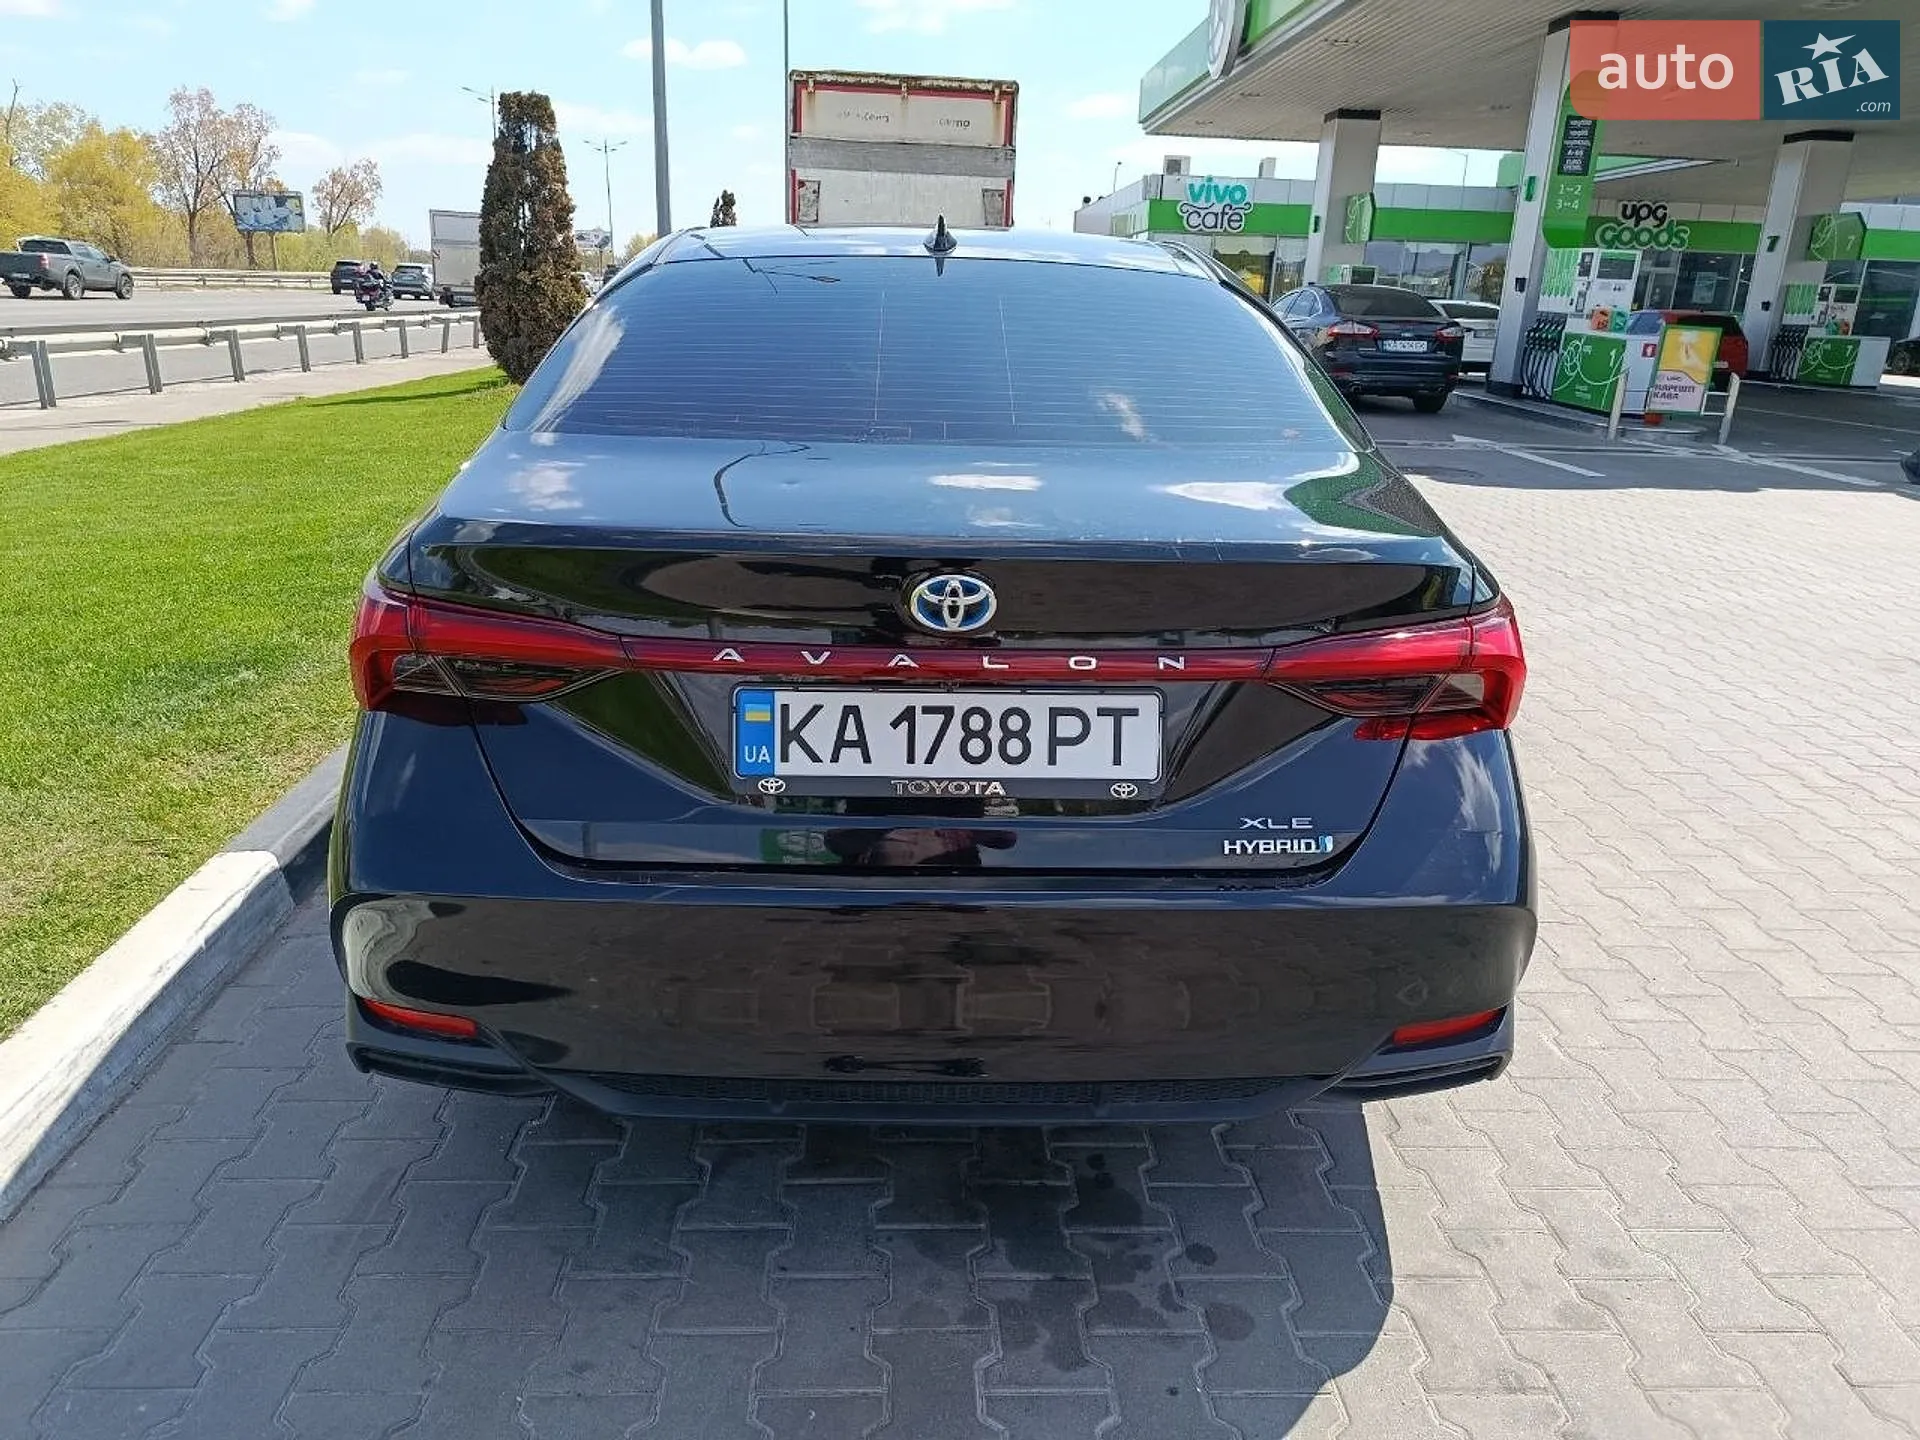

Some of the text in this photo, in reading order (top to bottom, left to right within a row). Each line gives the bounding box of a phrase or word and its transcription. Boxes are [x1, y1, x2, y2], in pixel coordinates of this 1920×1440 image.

[1188, 175, 1248, 204] vivo
[713, 647, 1186, 672] AVALON
[744, 703, 1140, 766] UA KA 1788 PT
[890, 779, 1007, 796] TOYOTA
[1239, 817, 1314, 830] XLE
[1223, 838, 1317, 855] HYBRID
